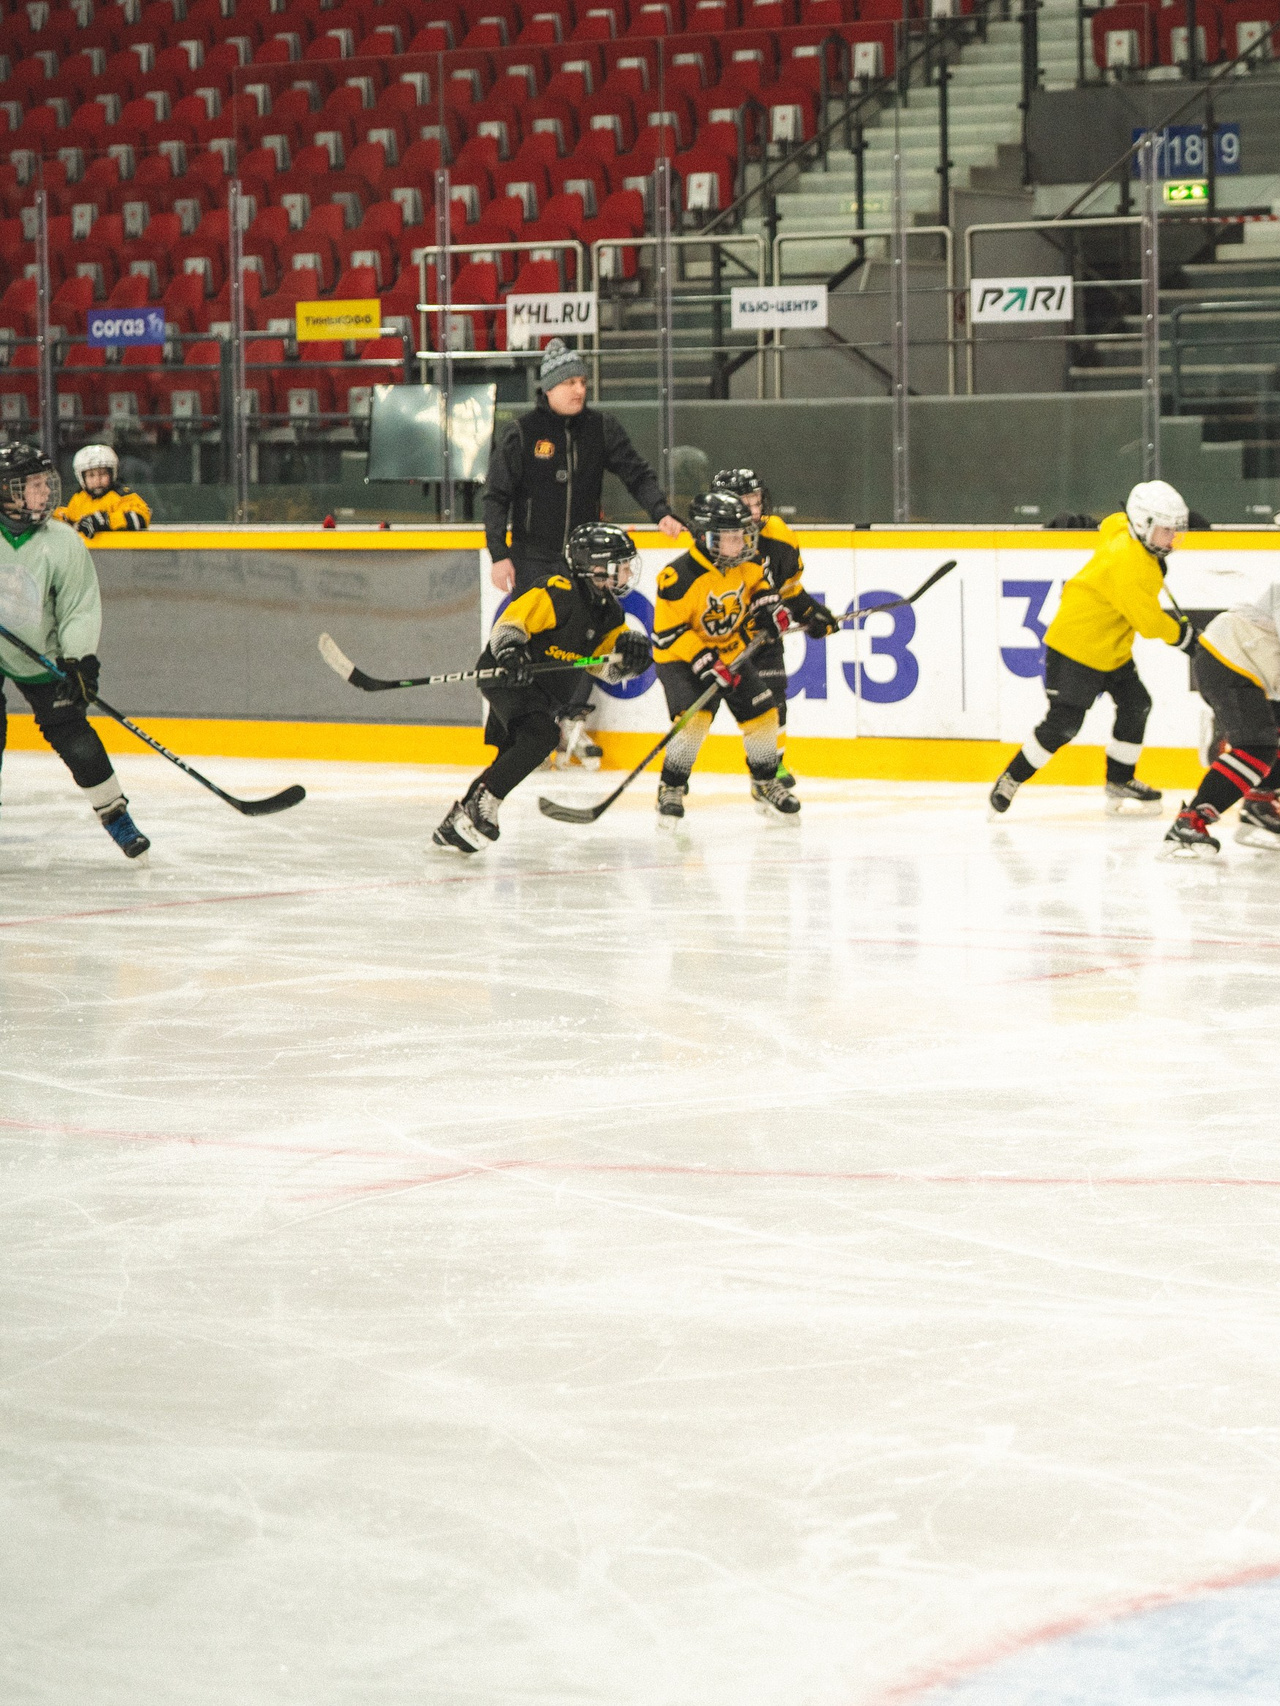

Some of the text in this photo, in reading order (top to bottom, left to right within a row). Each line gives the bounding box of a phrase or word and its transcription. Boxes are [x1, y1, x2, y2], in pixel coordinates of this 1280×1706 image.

[1169, 133, 1202, 166] 18
[1212, 132, 1240, 164] 9
[513, 302, 591, 324] KHL.RU
[739, 300, 818, 314] КЬЮ-ЦЕНТР
[978, 286, 1066, 313] PARI
